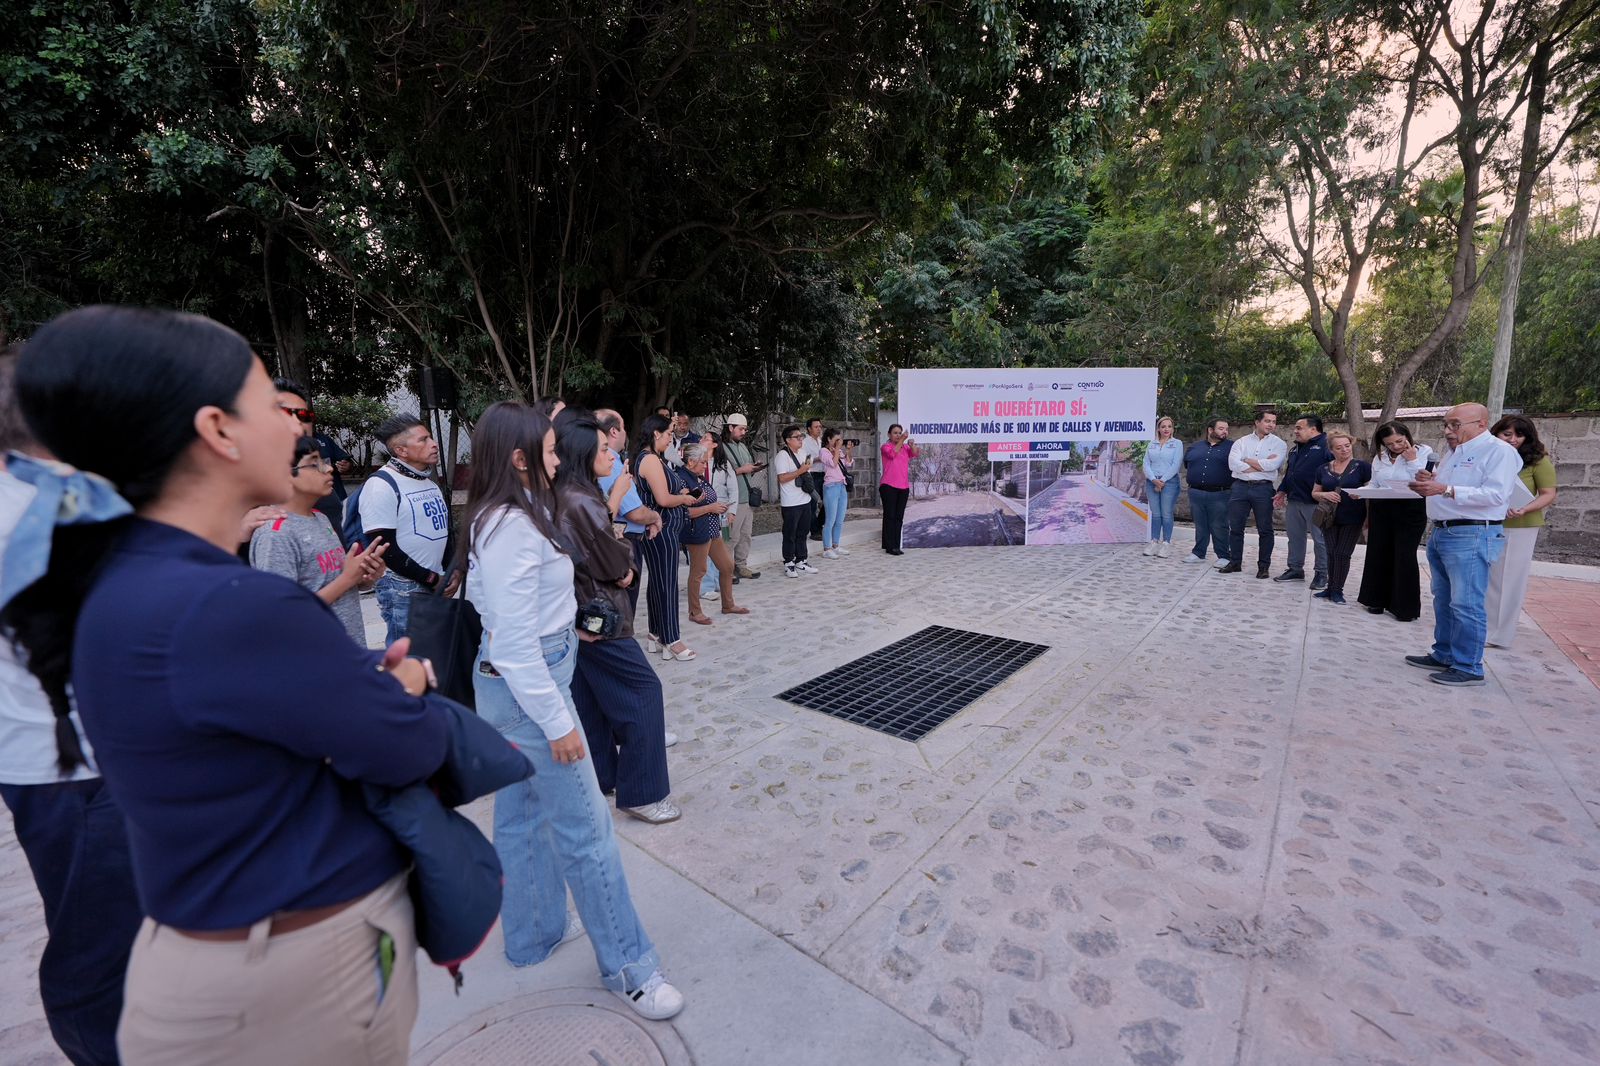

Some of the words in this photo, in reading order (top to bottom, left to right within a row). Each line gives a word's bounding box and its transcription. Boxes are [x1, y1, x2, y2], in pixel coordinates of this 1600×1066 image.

[973, 400, 990, 416] EN
[995, 397, 1066, 416] QUERÉTARO
[1070, 396, 1088, 416] SÍ:
[910, 422, 978, 434] MODERNIZAMOS
[981, 420, 1000, 434] MÁS
[1003, 422, 1014, 434] DE
[1016, 422, 1030, 434] 100
[1032, 422, 1046, 433] KM
[1049, 422, 1060, 433] DE
[1062, 421, 1092, 433] CALLES
[1094, 421, 1102, 432] Y
[1104, 420, 1146, 432] AVENIDAS.
[432, 513, 446, 531] en
